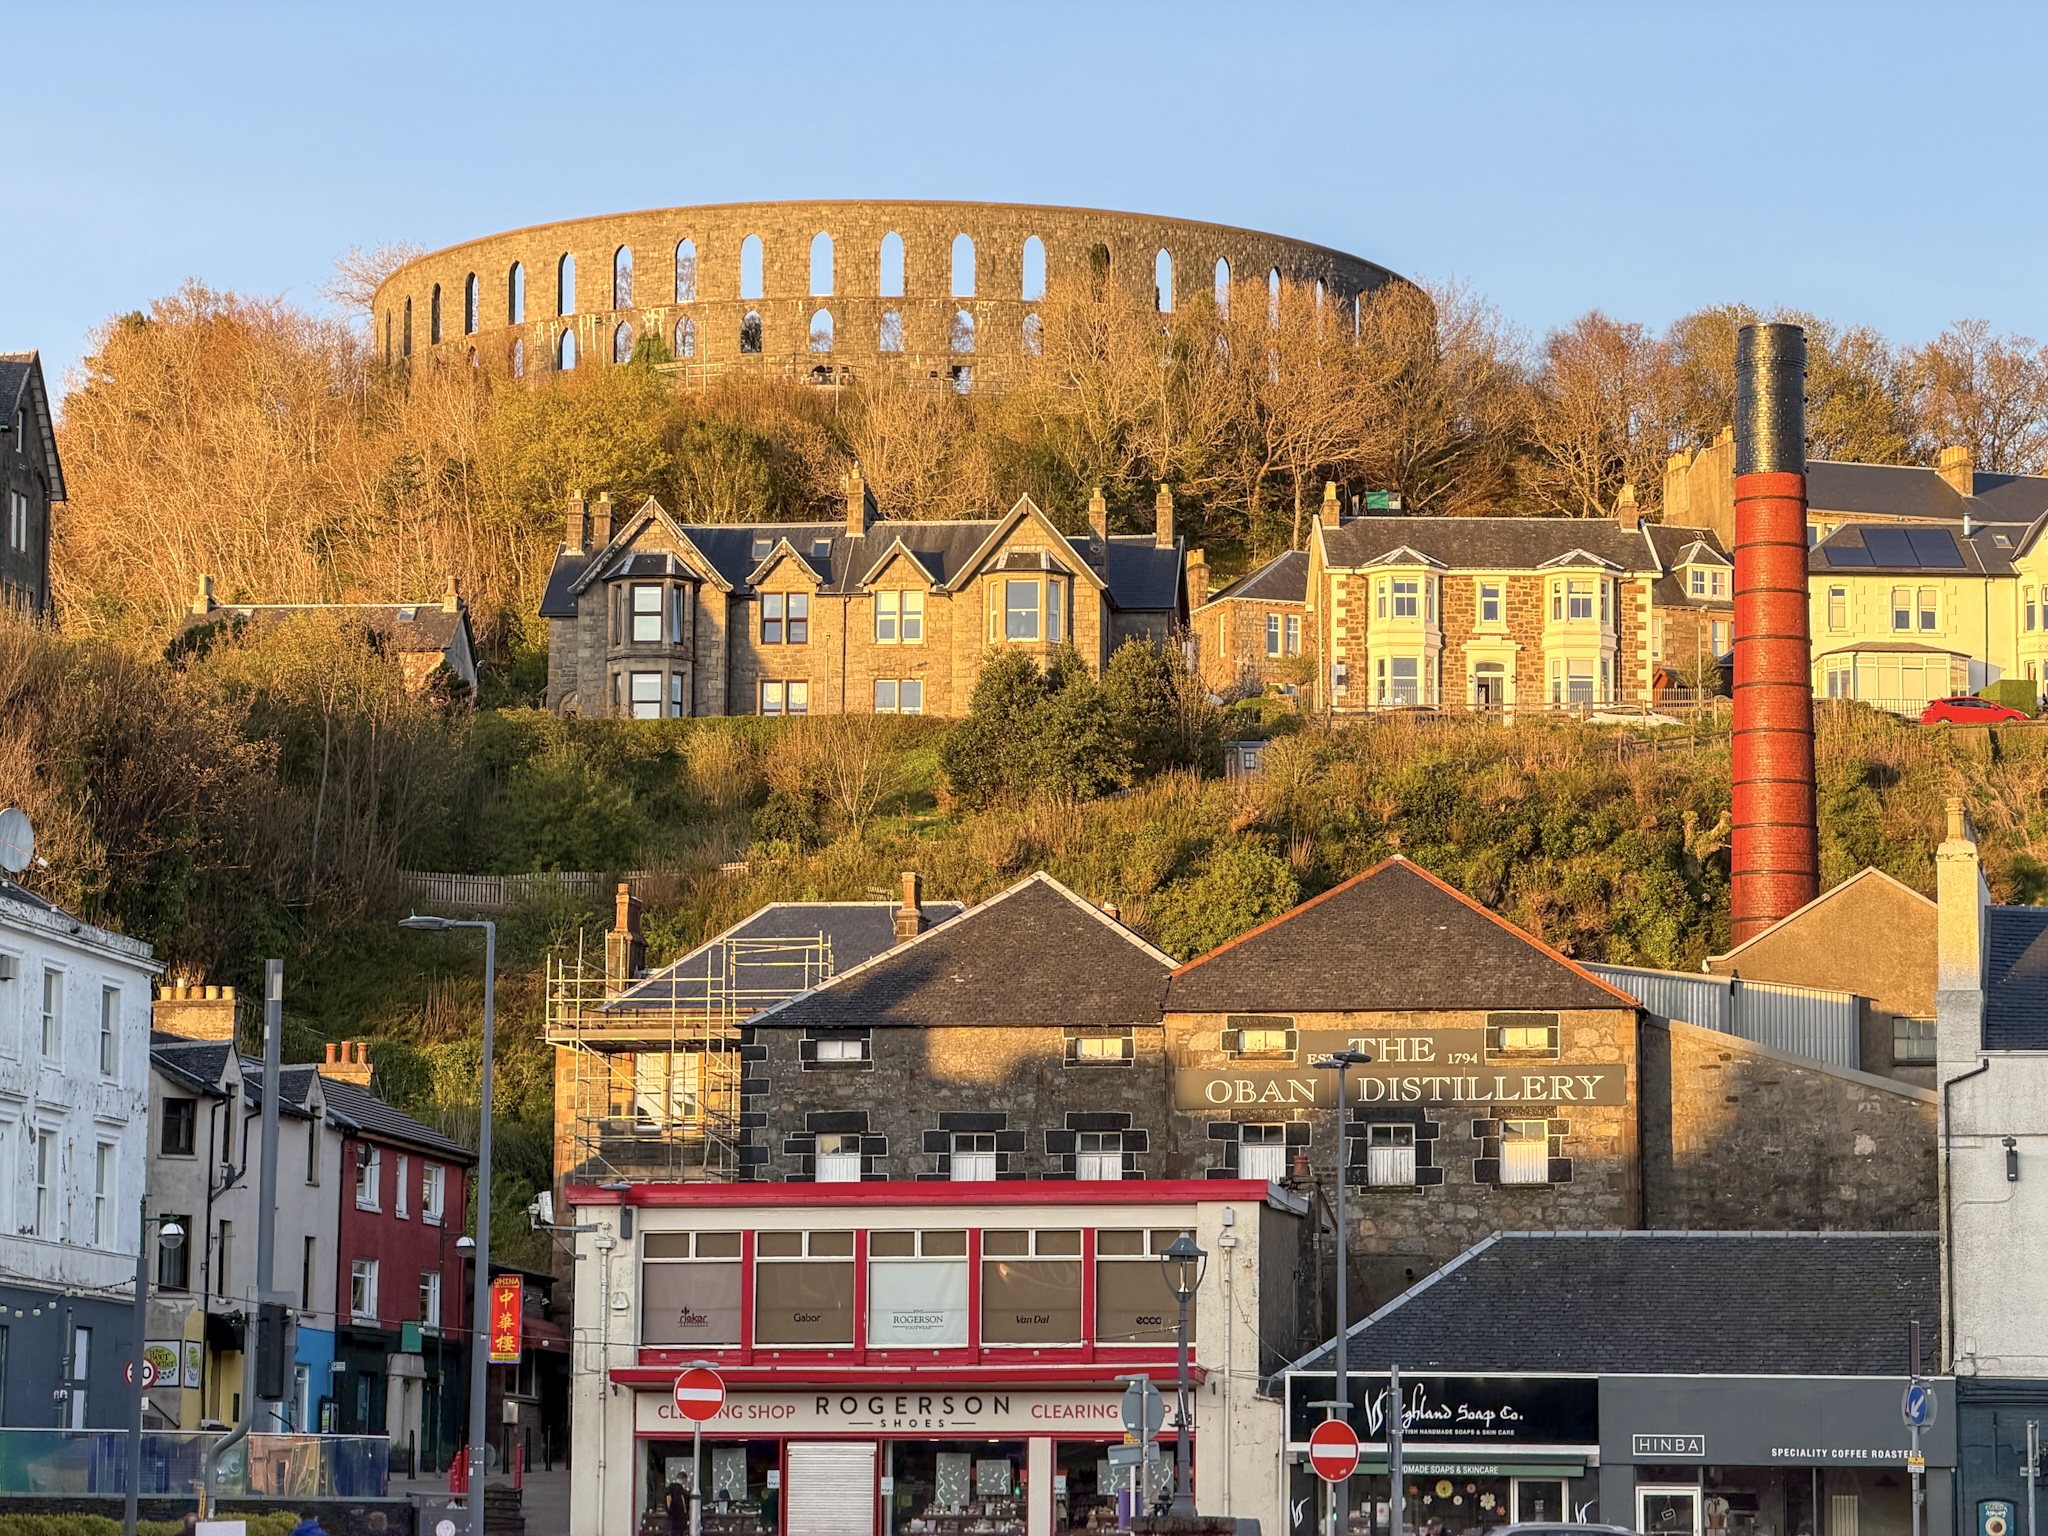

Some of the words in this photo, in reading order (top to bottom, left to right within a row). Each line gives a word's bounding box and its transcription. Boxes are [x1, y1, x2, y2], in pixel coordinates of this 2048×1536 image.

[1348, 1037, 1436, 1062] THE
[1447, 1053, 1478, 1064] 1794
[1205, 1078, 1318, 1104] OBAN
[1358, 1075, 1606, 1103] DISTILLERY
[494, 1277, 520, 1287] CHINA
[680, 1306, 708, 1323] rieker
[793, 1312, 822, 1323] Gabor
[893, 1315, 943, 1324] ROGERSON
[1016, 1315, 1032, 1324] Van
[1033, 1314, 1050, 1324] Dal
[1136, 1316, 1162, 1325] ecco
[816, 1396, 1010, 1415] ROGERSON
[748, 1405, 796, 1419] SHOP
[1031, 1404, 1118, 1419] CLEARING
[1456, 1403, 1496, 1428] Soap
[1499, 1405, 1524, 1421] Co.
[880, 1419, 945, 1428] SHOES
[1639, 1438, 1699, 1452] HINBA
[1771, 1448, 1828, 1458] SPECIALITY
[1831, 1449, 1868, 1459] COFFEE
[1430, 1465, 1455, 1474] SOAPS
[1456, 1465, 1462, 1474] &
[1462, 1465, 1499, 1475] SKINCARE
